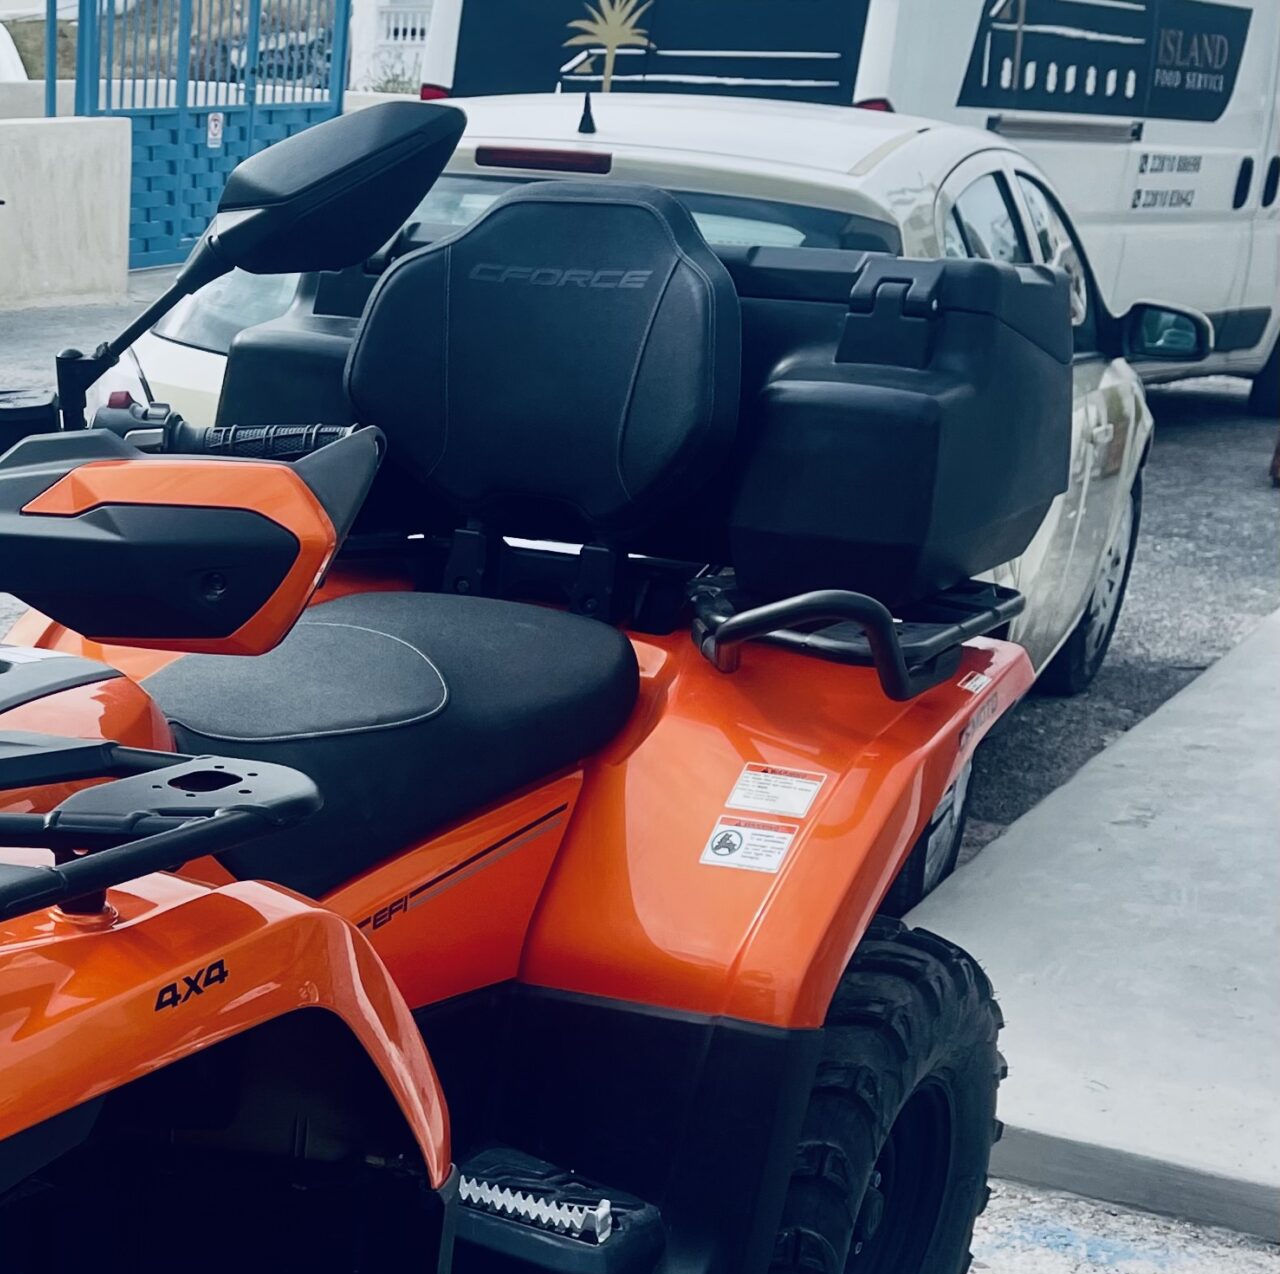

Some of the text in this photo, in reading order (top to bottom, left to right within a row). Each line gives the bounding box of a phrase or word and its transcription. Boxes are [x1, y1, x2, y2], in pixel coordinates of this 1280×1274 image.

[1158, 28, 1229, 70] ISLAND
[1154, 68, 1182, 89] FOOD
[469, 263, 653, 289] CFORCE
[373, 894, 408, 930] EFI
